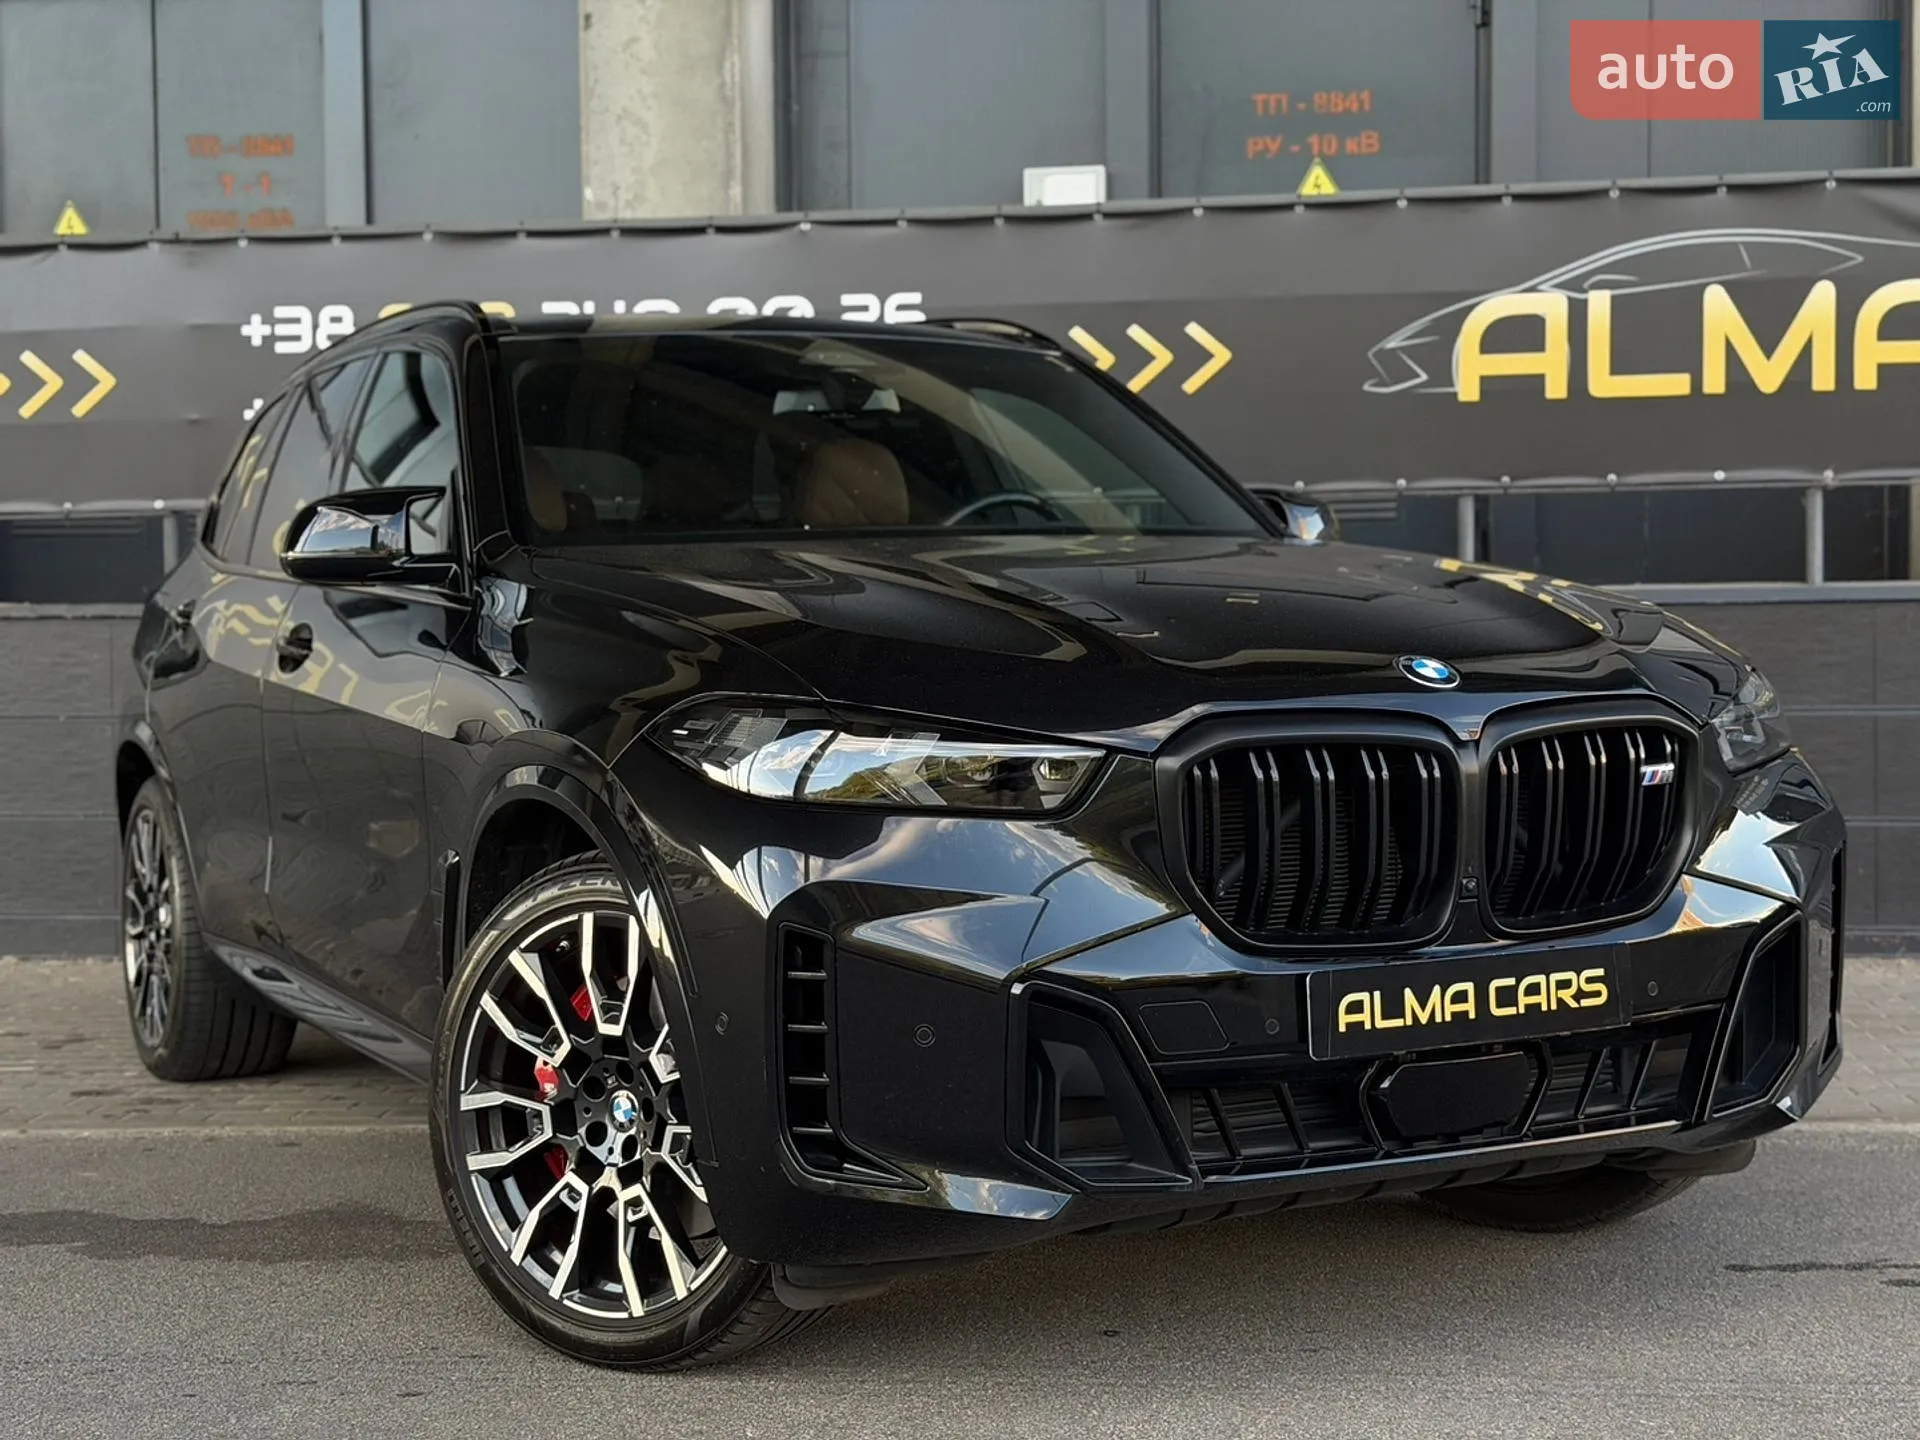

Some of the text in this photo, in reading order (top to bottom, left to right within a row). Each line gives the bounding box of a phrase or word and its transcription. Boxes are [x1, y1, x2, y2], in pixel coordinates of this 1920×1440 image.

[1251, 93, 1289, 116] ТП
[1247, 134, 1283, 160] РУ
[1306, 132, 1339, 157] 10
[1457, 278, 1920, 402] ALMA
[1338, 968, 1610, 1033] ALMA CARS
